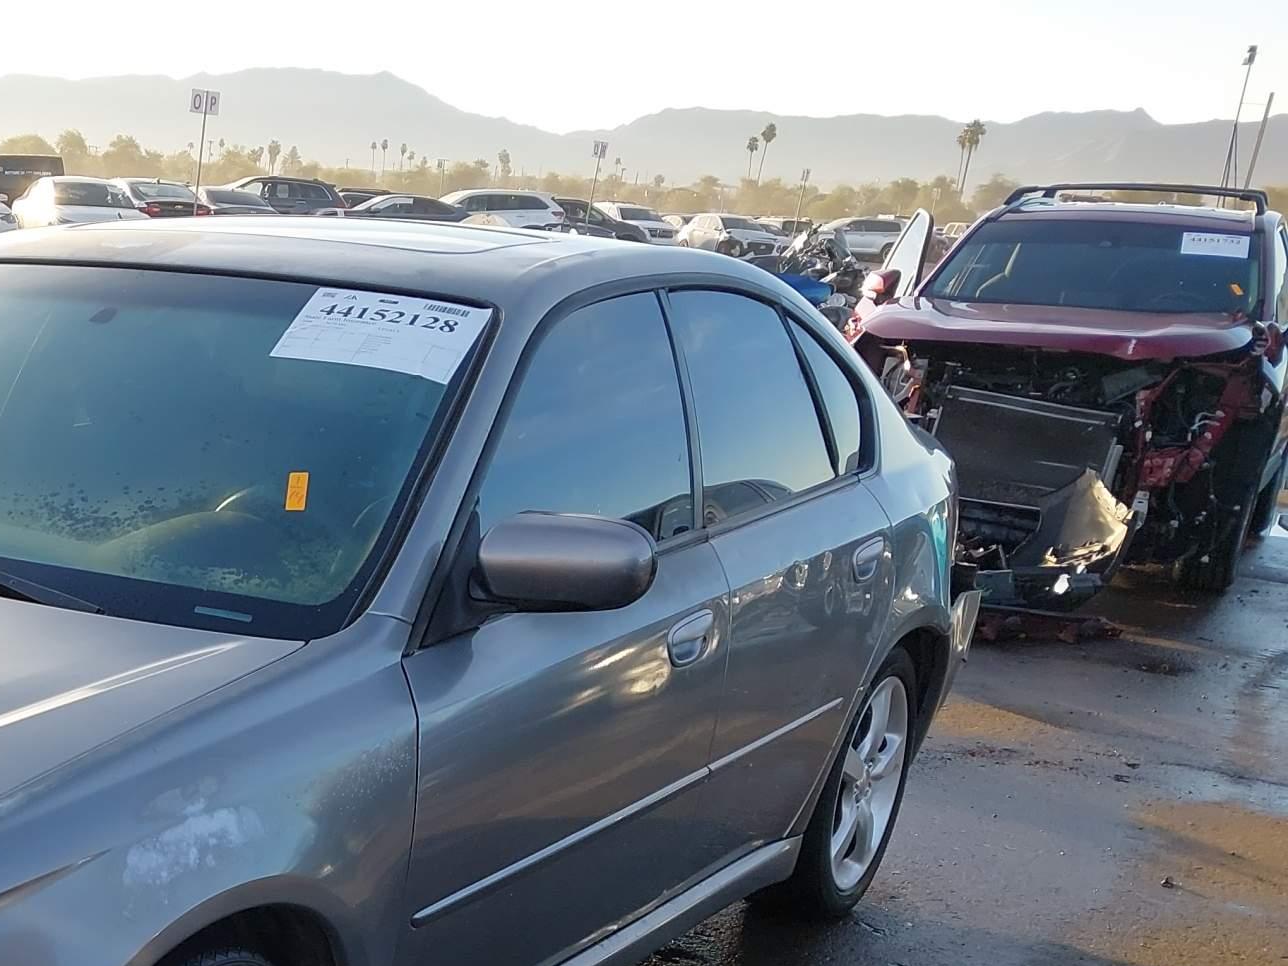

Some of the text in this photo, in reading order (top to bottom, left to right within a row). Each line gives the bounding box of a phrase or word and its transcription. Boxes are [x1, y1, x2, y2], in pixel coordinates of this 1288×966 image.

[193, 93, 217, 111] O P
[319, 303, 459, 333] 44152128
